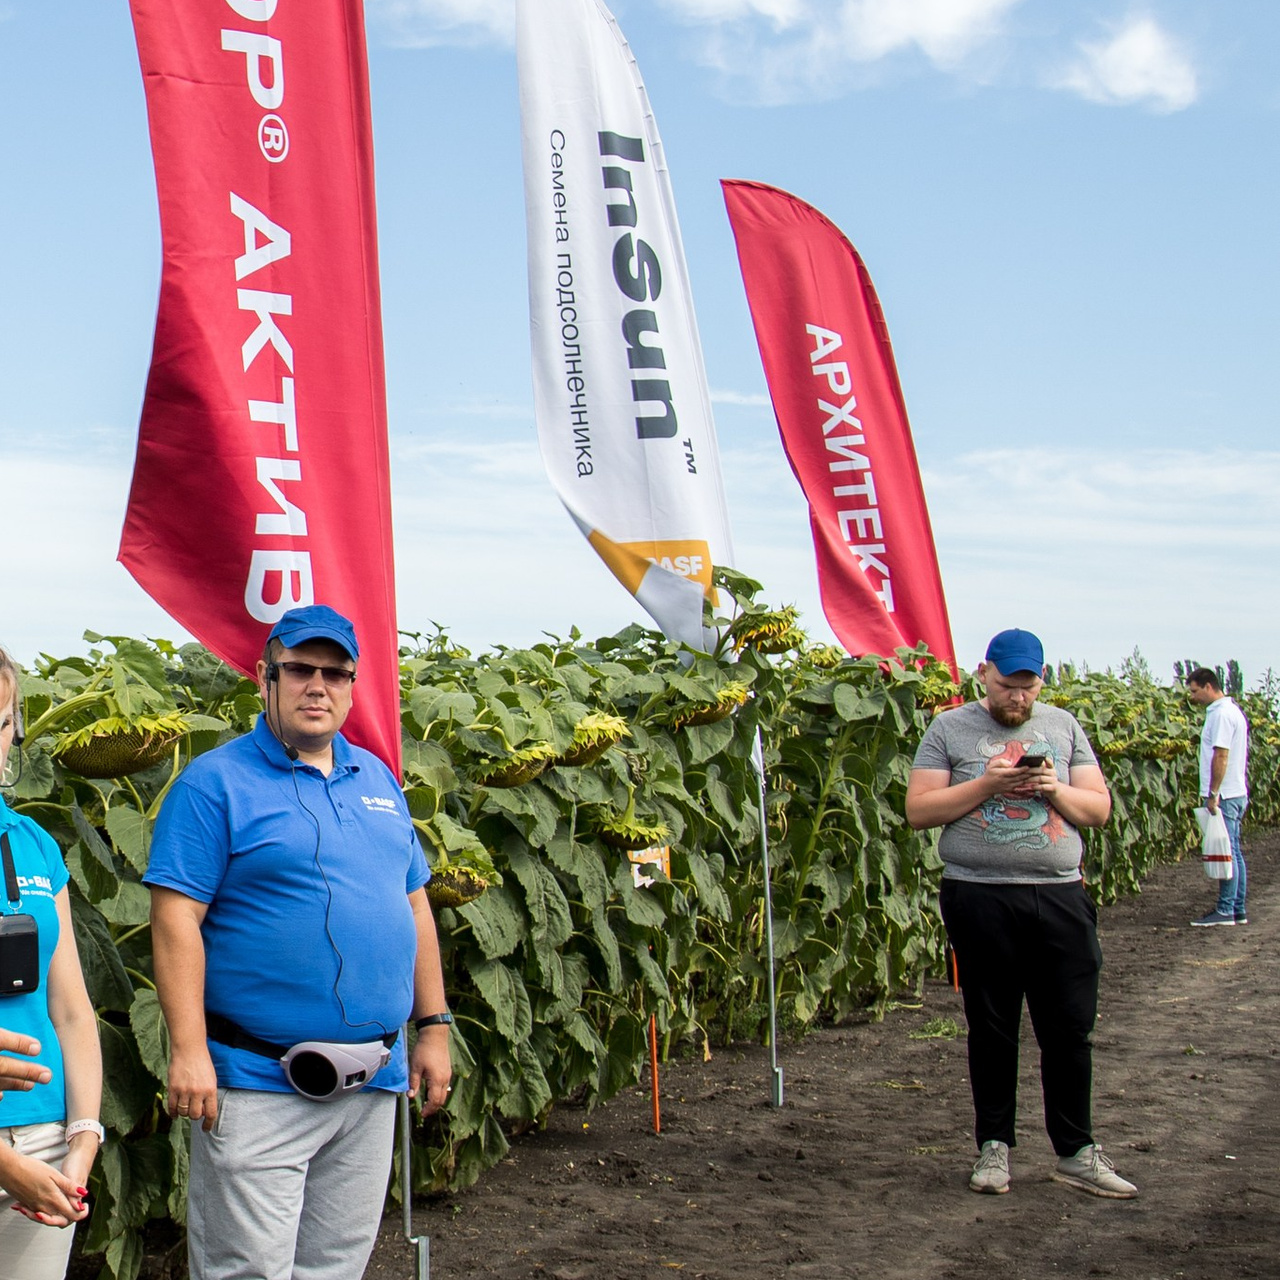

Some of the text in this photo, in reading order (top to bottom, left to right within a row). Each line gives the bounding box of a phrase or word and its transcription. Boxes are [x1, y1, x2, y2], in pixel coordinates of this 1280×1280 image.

[229, 191, 315, 624] АКТИВ
[549, 130, 594, 478] Семена подсолнечника
[805, 323, 895, 613] АРХИТЕКТ
